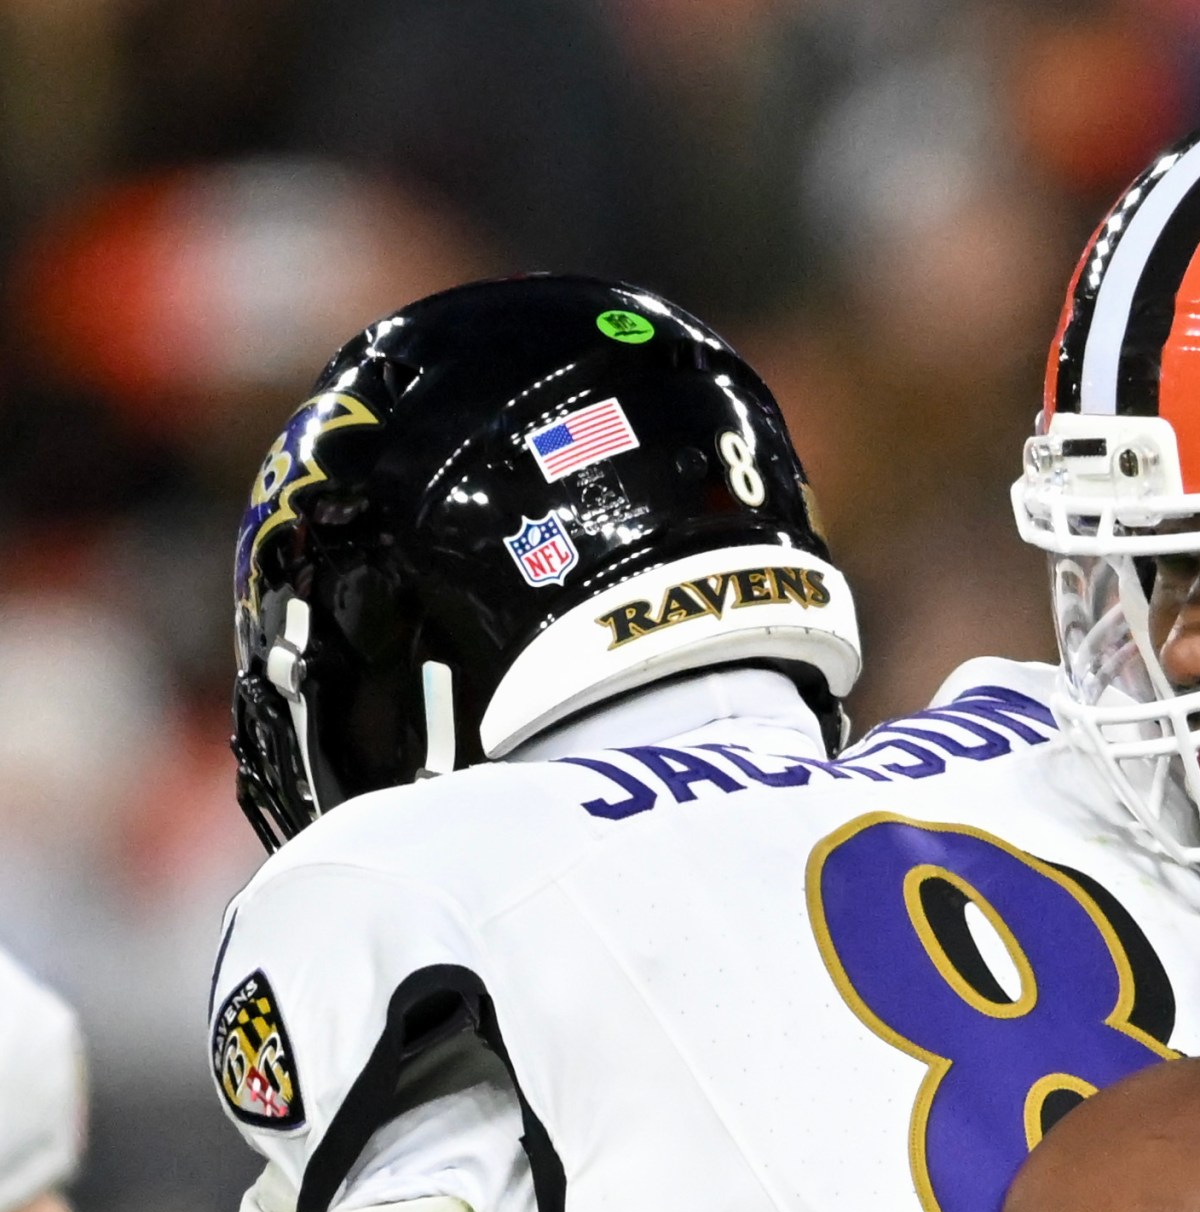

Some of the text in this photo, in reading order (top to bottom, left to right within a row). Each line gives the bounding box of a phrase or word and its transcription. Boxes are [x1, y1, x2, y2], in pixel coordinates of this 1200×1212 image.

[718, 430, 766, 507] 8
[524, 541, 570, 578] NFL
[594, 566, 831, 651] RAVENS
